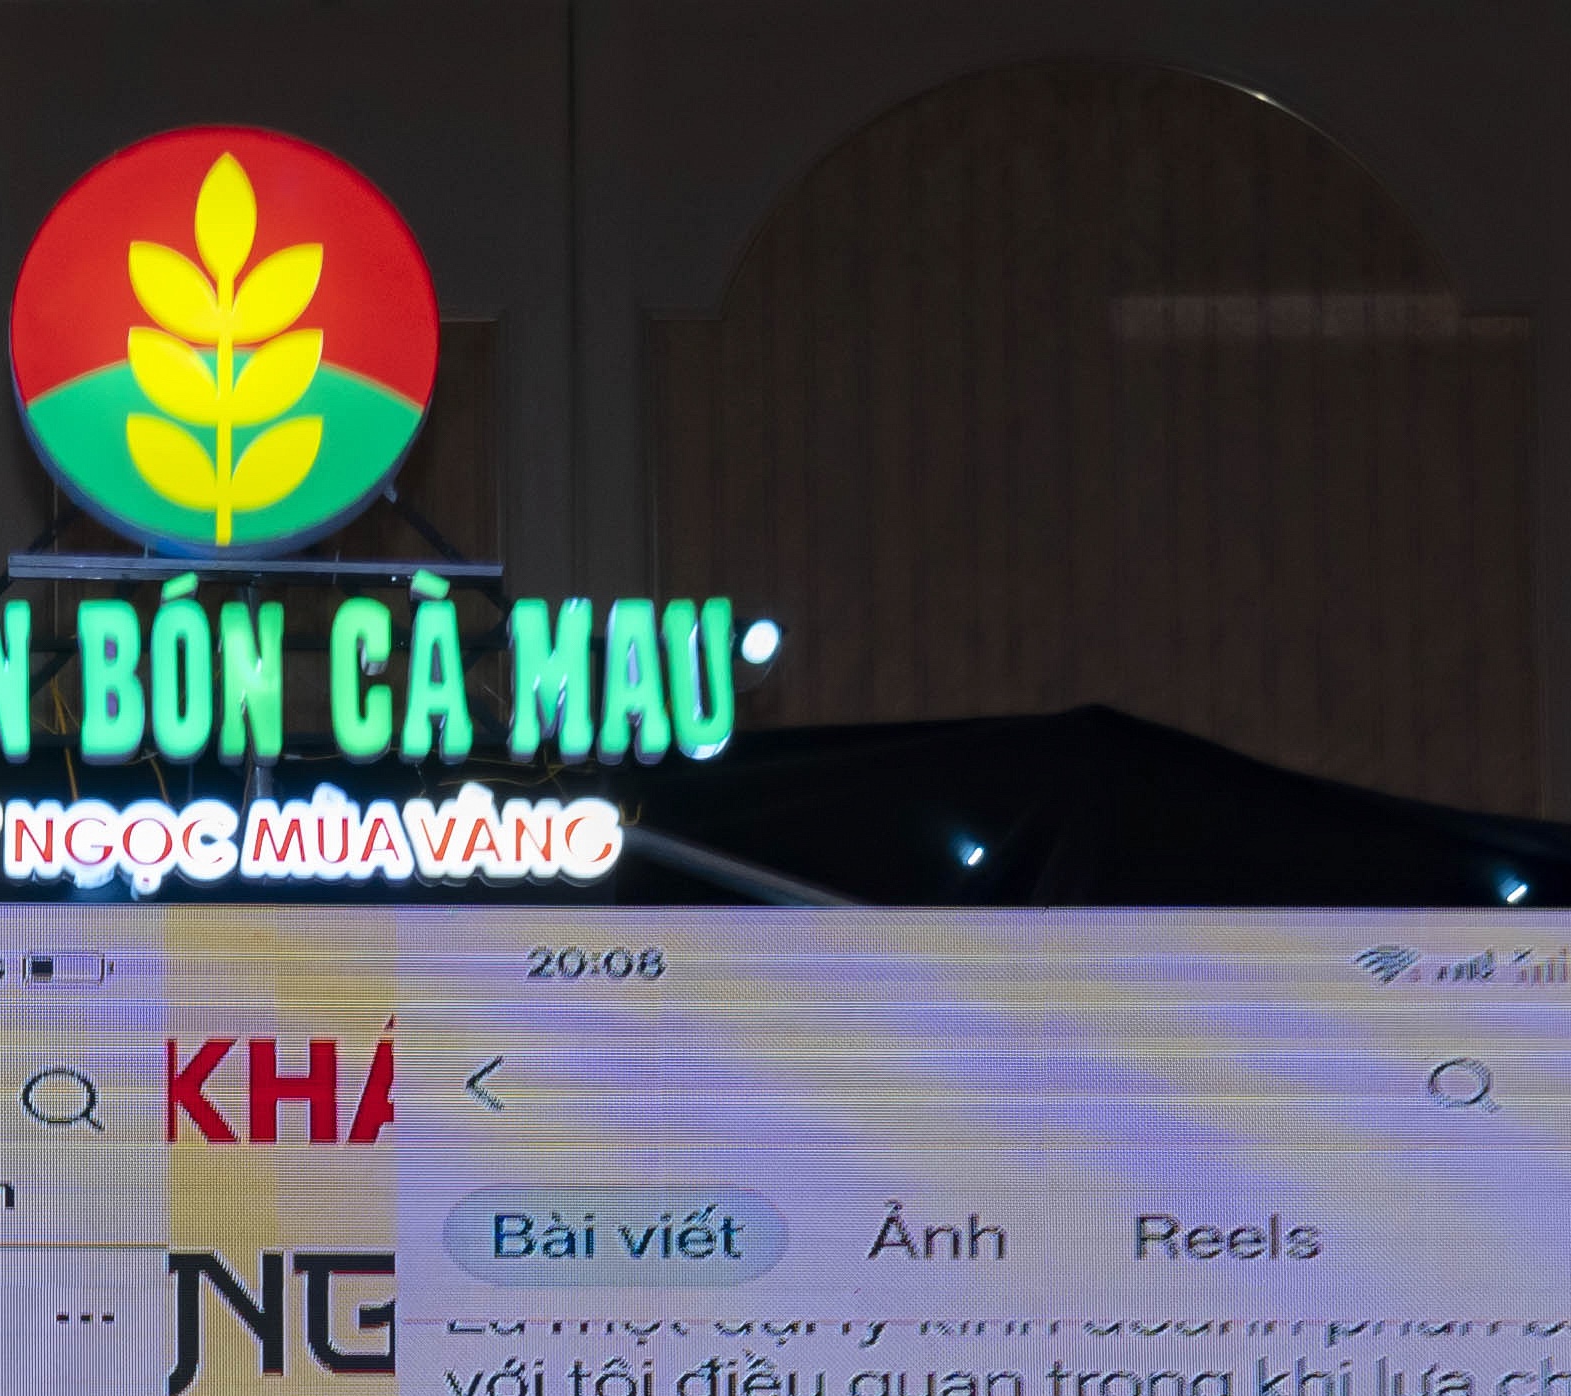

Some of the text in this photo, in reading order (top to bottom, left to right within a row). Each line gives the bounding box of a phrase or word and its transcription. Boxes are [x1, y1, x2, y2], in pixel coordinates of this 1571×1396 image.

[77, 571, 284, 767] BÓN
[328, 569, 473, 765] CÀ
[508, 596, 733, 767] MAU
[1, 798, 237, 897] NGỌC
[241, 783, 411, 884] MÙA
[411, 783, 623, 884] VÀNG
[493, 1203, 744, 1261] Bài viết
[867, 1200, 1007, 1261] Ảnh
[1134, 1212, 1321, 1261] Reels
